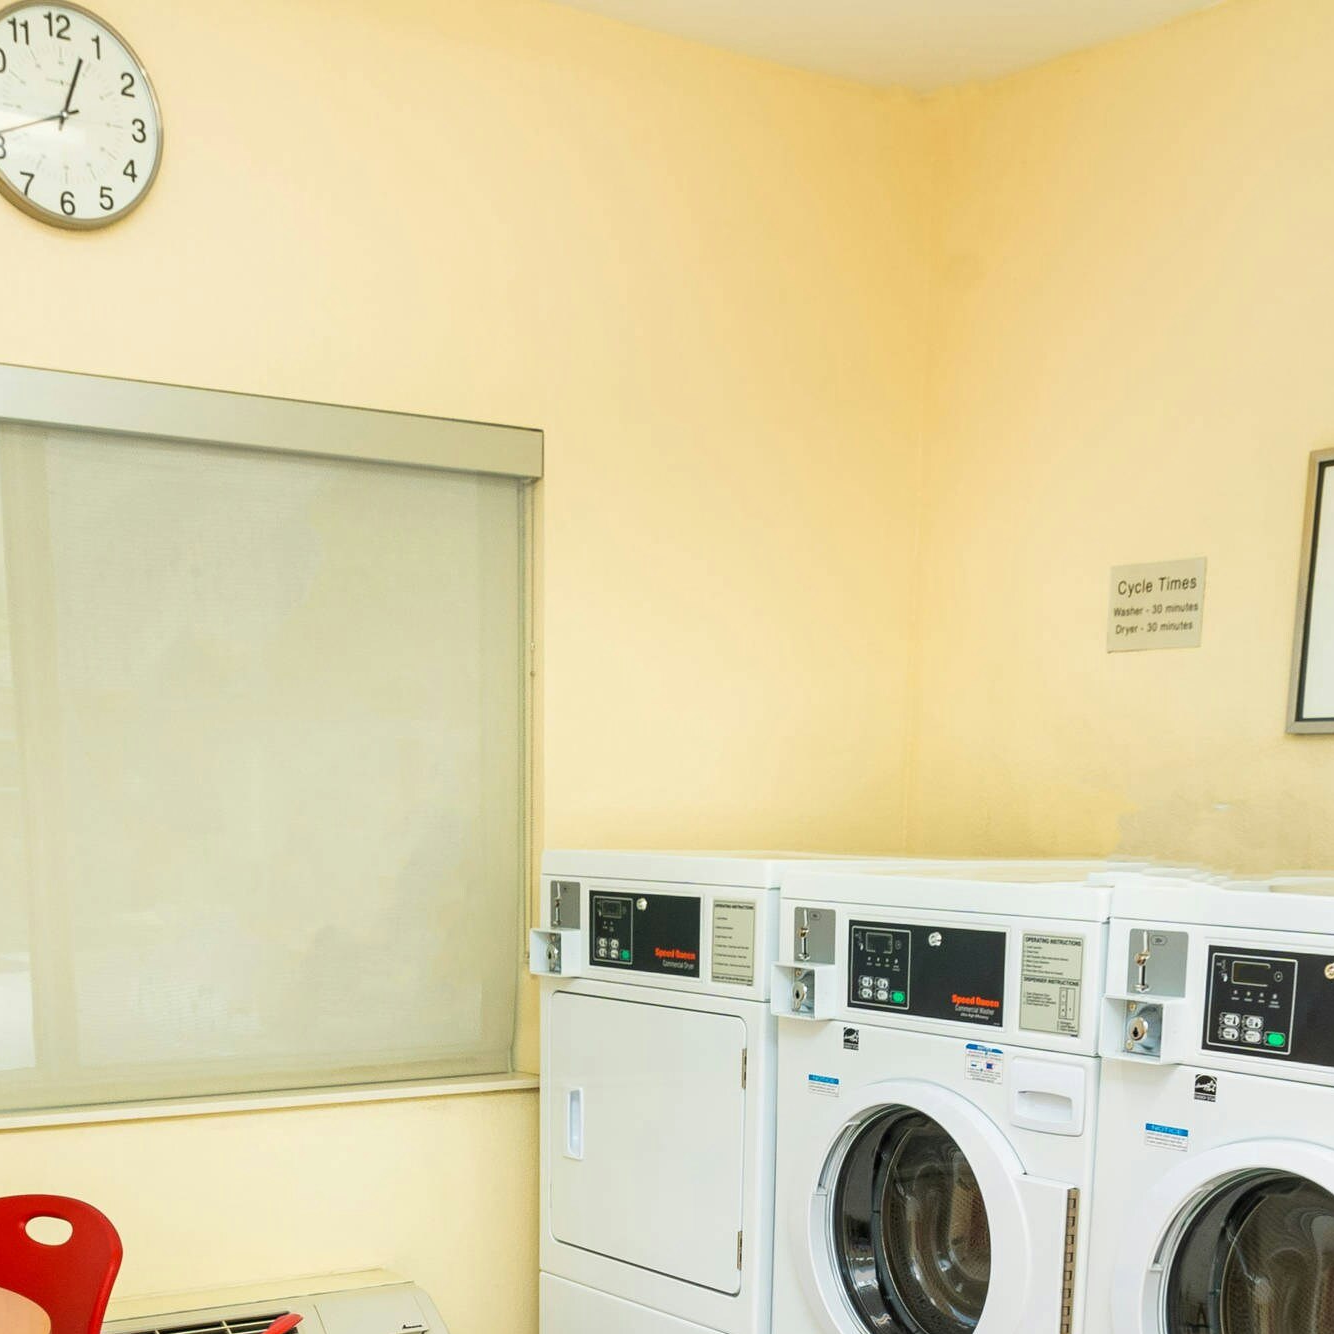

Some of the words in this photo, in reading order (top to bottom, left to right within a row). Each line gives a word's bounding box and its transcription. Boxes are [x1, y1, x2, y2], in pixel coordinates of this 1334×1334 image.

[8, 18, 29, 45] 11
[43, 12, 71, 41] 12
[92, 35, 100, 60] 1
[121, 73, 135, 97] 2
[132, 119, 146, 143] 3
[20, 171, 34, 196] 7
[123, 160, 137, 183] 4
[61, 191, 75, 215] 6
[100, 187, 113, 210] 5
[1118, 579, 1153, 597] Cycle
[1159, 577, 1197, 591] Times
[1114, 607, 1143, 616] Washer
[1165, 603, 1198, 613] minutes
[1116, 624, 1138, 635] Dryer
[1160, 622, 1193, 631] minutes
[952, 994, 975, 1004] Speed
